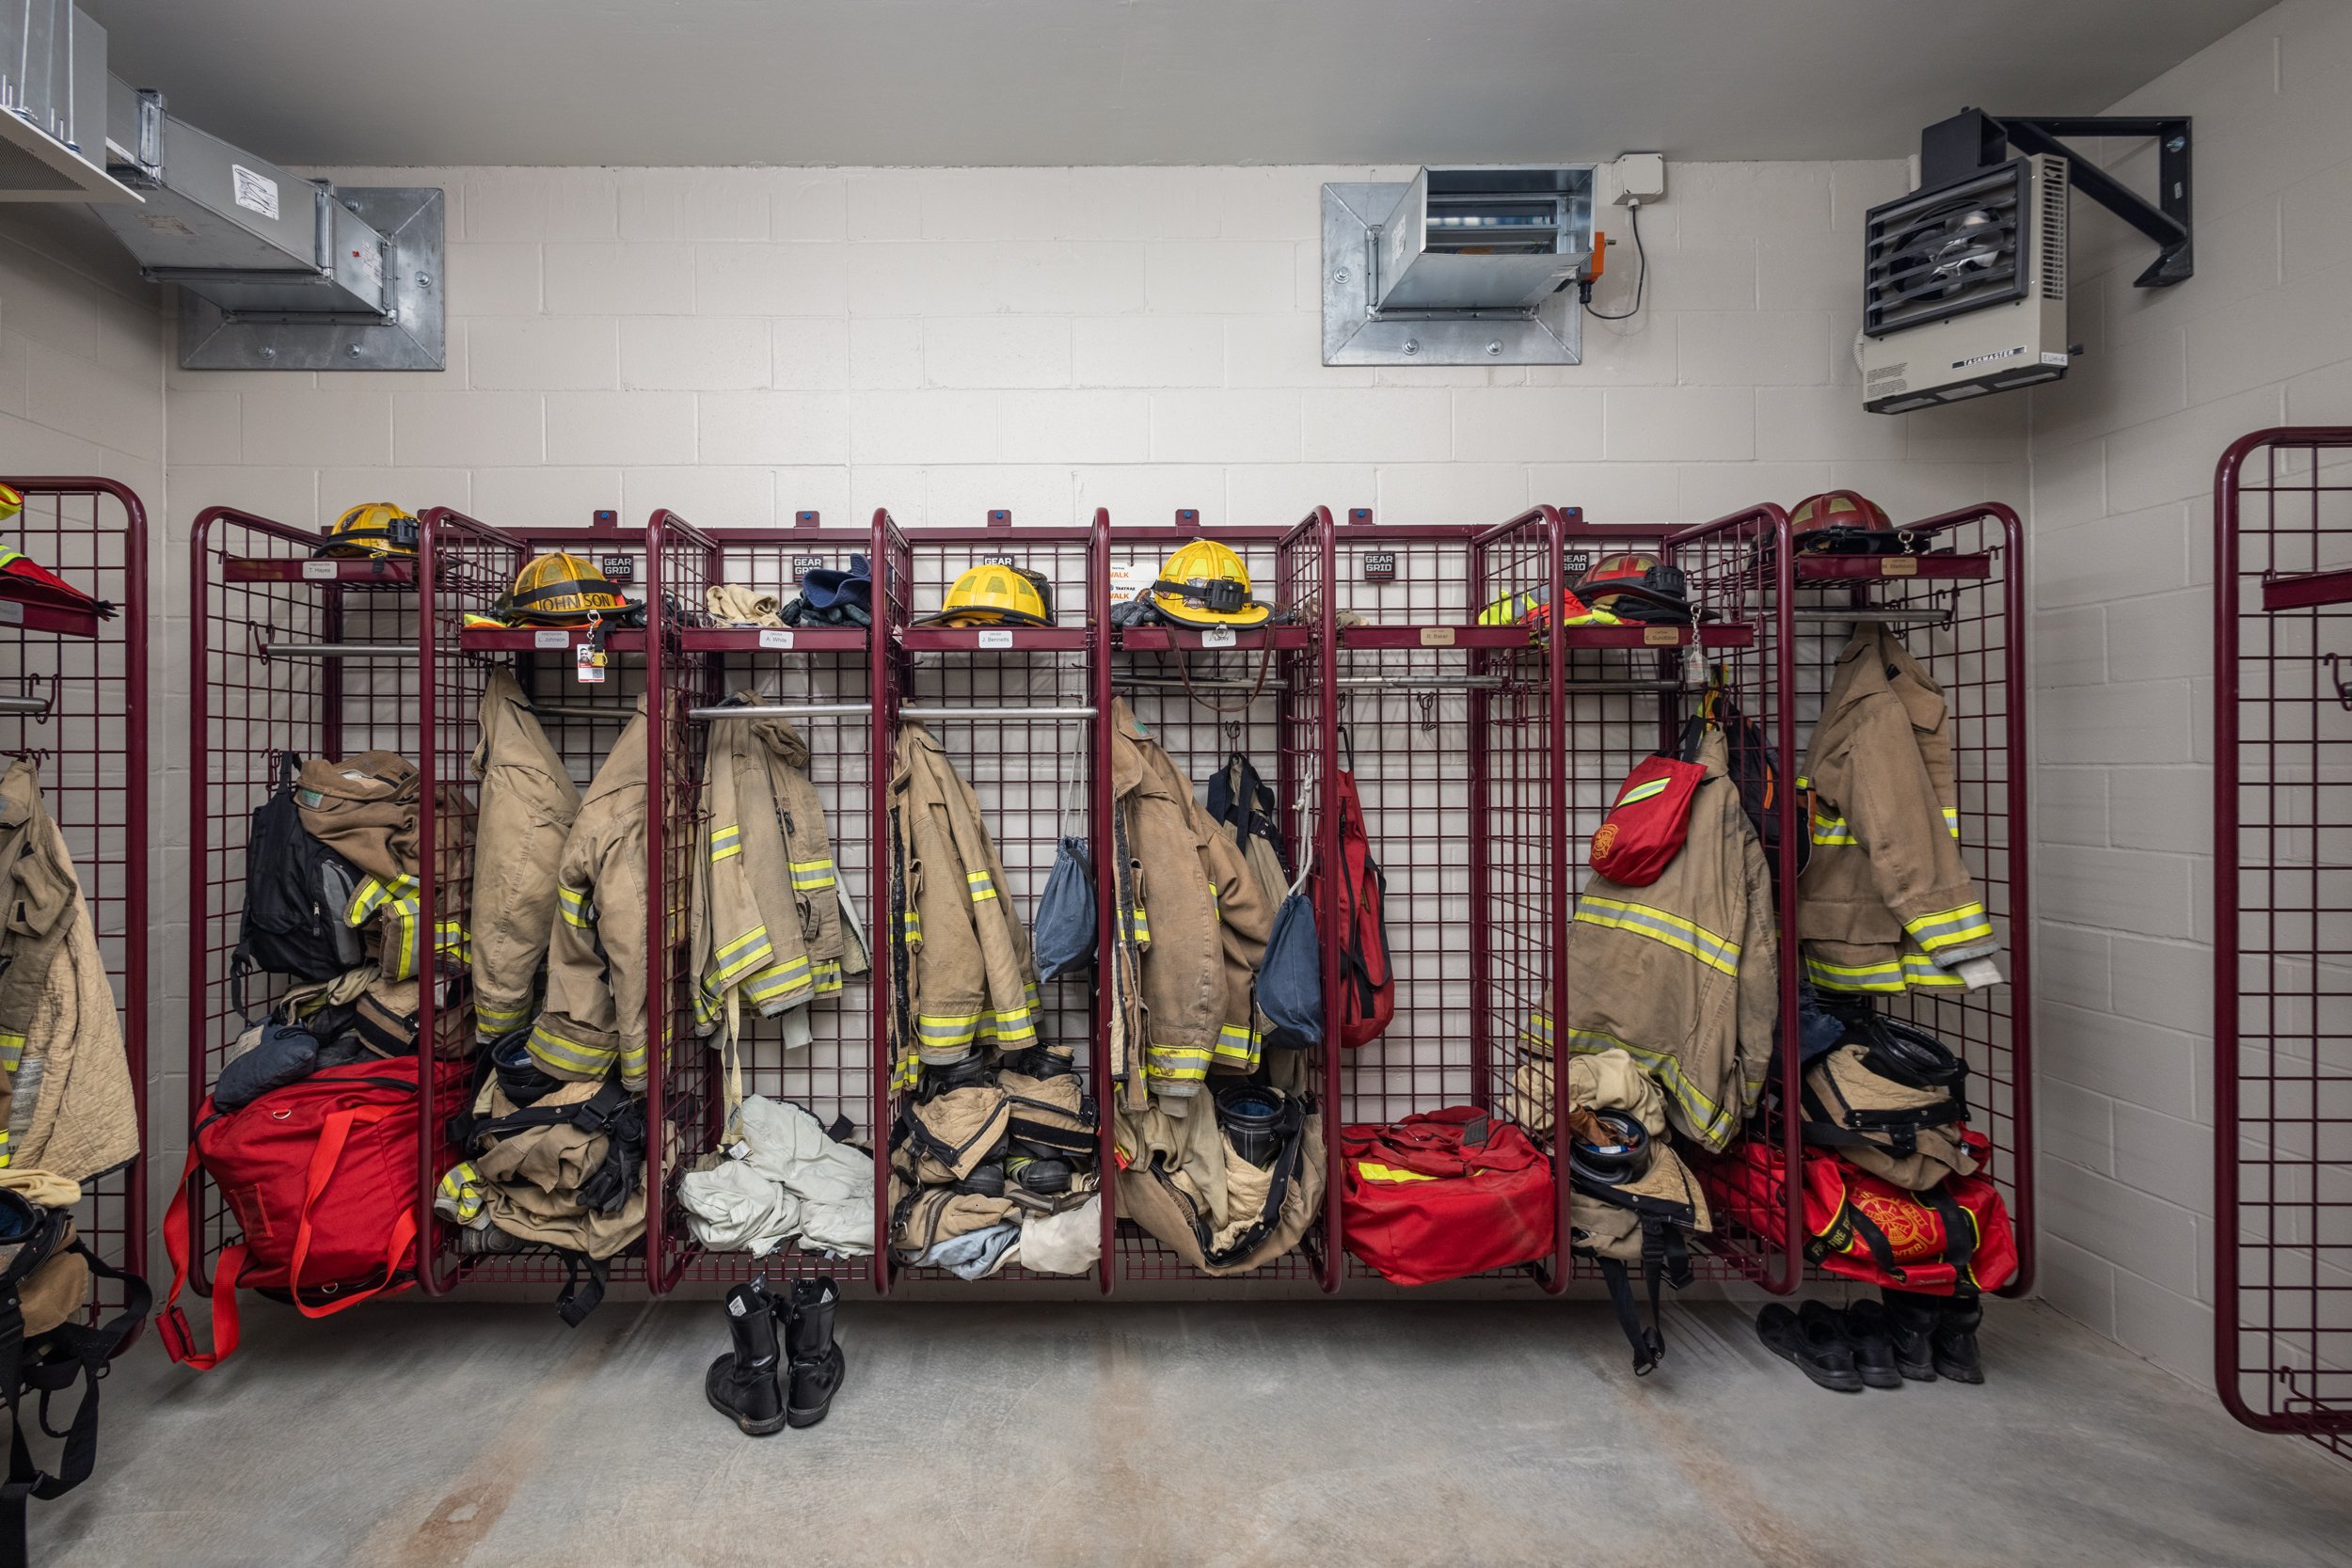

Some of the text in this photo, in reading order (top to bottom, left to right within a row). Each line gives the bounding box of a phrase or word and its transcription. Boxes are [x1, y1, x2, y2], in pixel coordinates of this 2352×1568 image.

[1963, 349, 2013, 367] TASKMASTER
[604, 558, 632, 566] GEAR
[794, 558, 821, 566] GEAR
[984, 557, 1012, 565] GEAR
[1365, 555, 1393, 563] GEAR
[1366, 563, 1392, 572] GRID
[1827, 1228, 1847, 1248] FIRE
